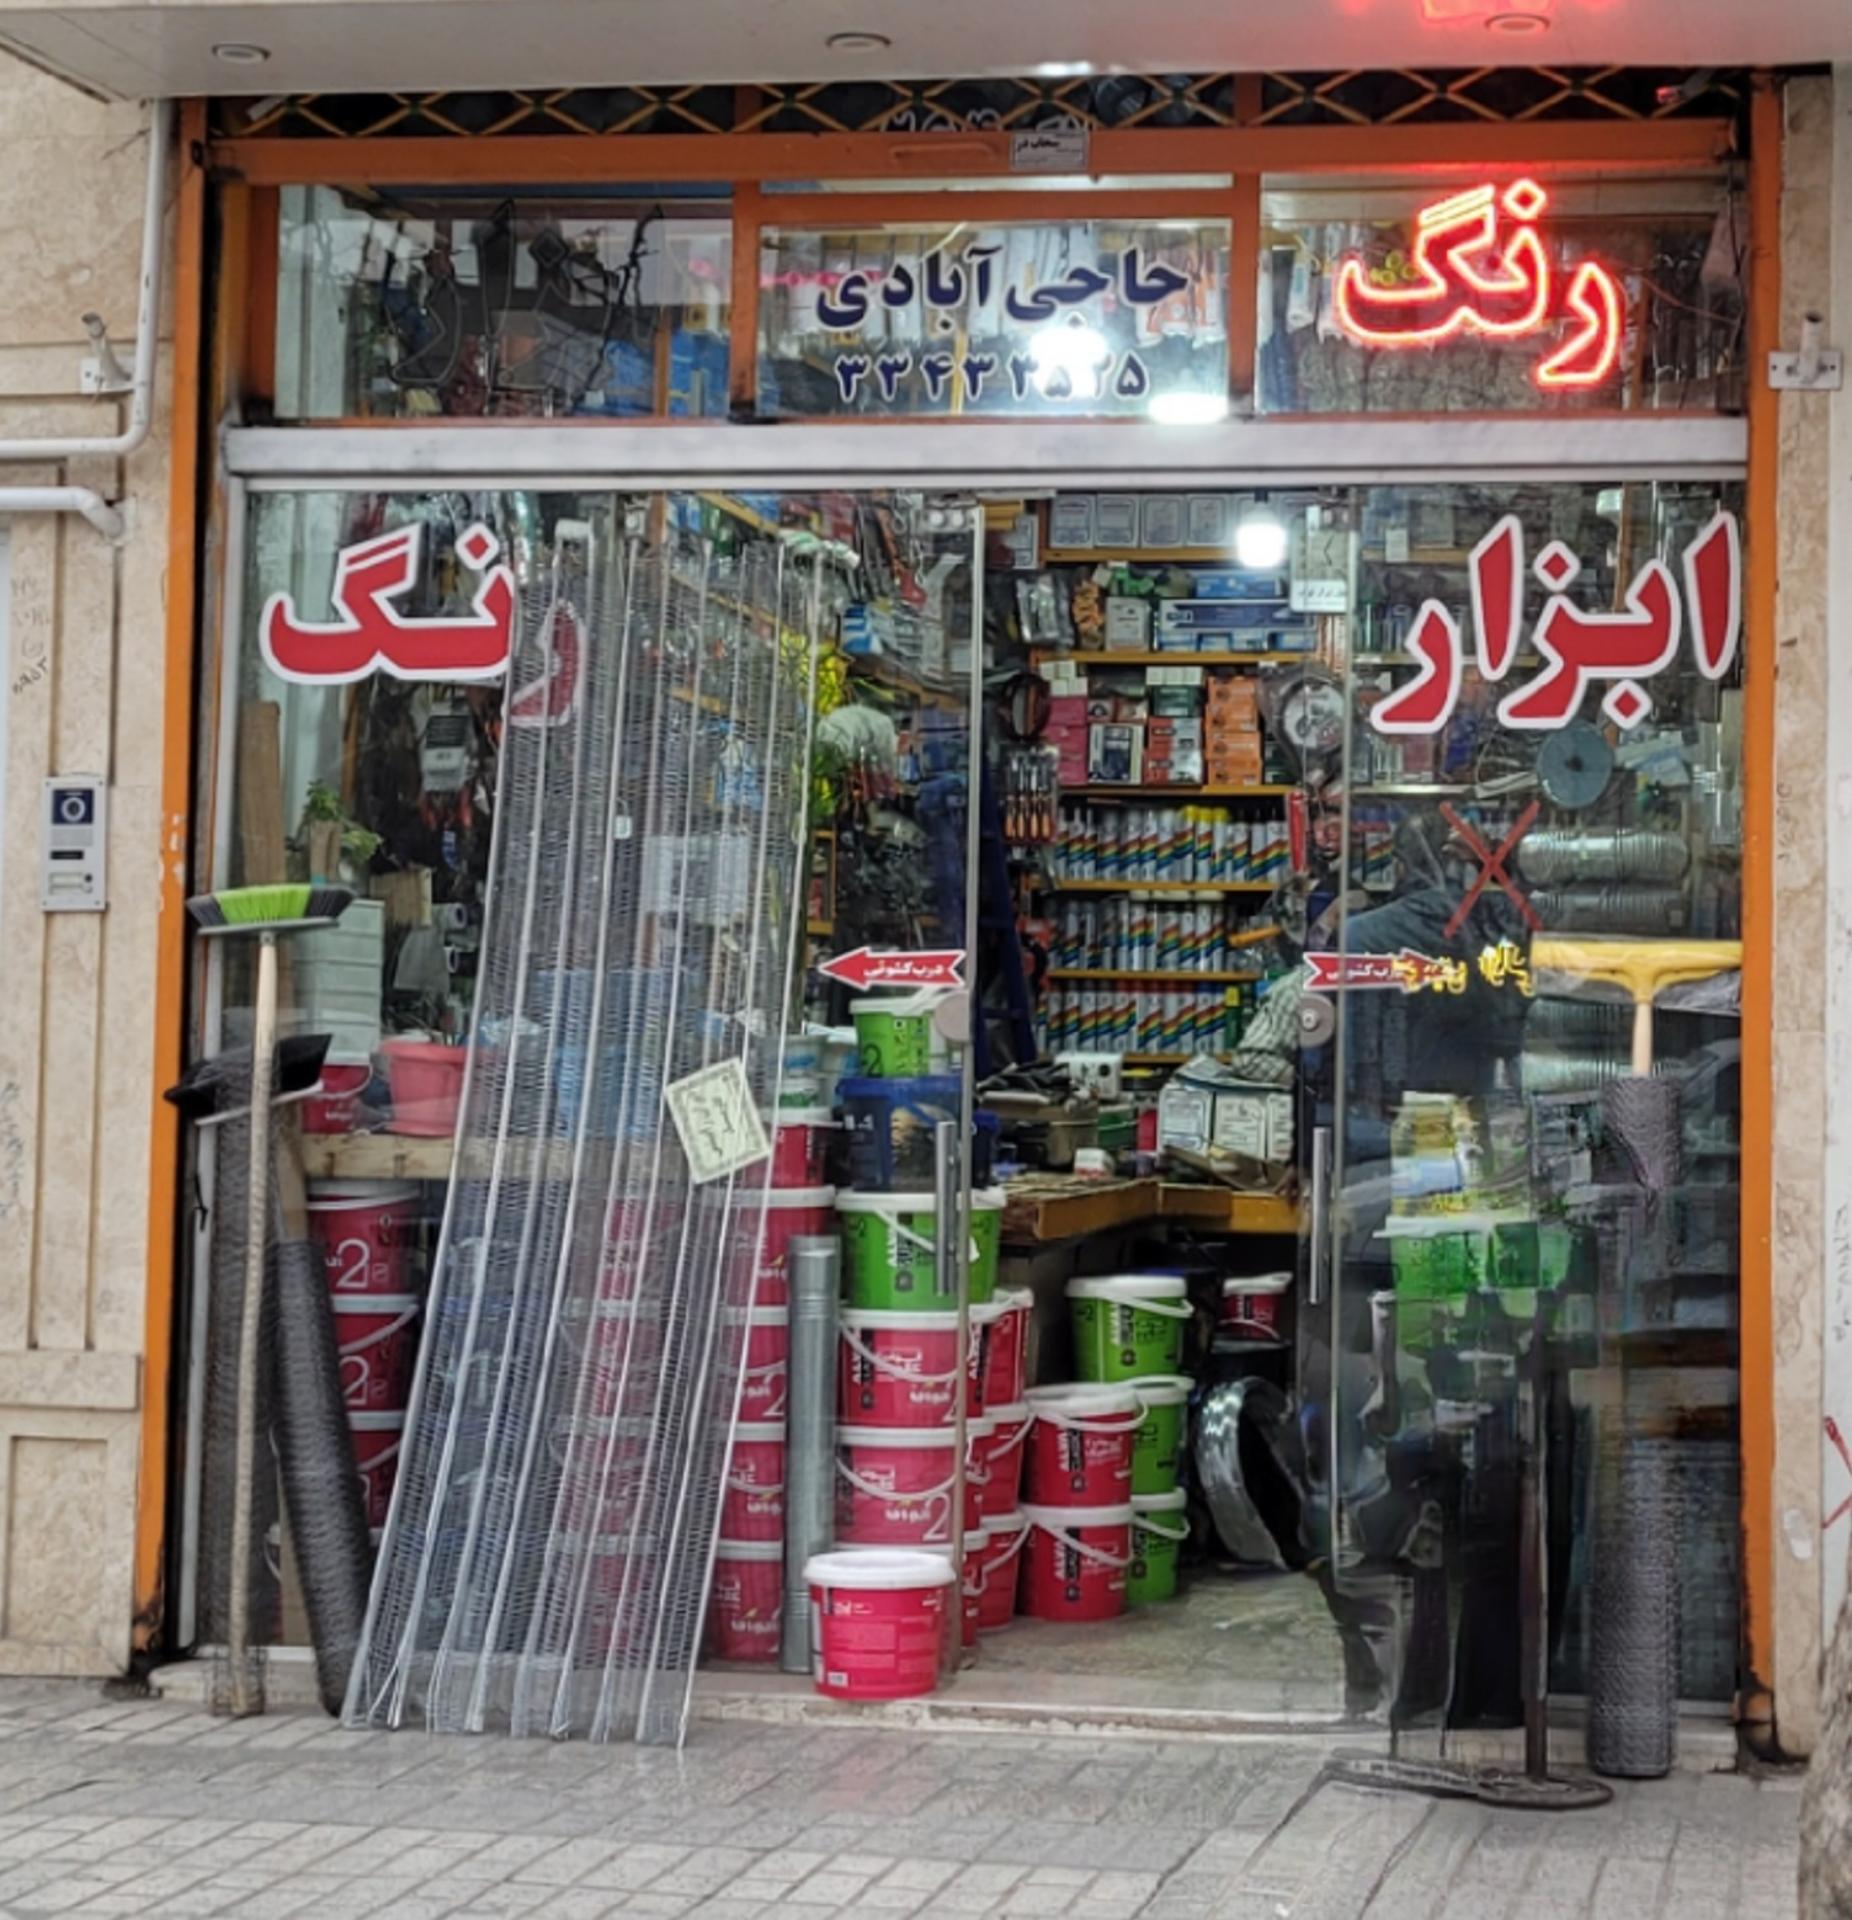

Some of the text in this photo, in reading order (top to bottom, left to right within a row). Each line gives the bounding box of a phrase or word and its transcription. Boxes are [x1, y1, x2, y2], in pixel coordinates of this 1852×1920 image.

[816, 245, 1190, 330] حاجی آبادی
[1333, 176, 1625, 388] رنگ
[260, 522, 590, 728] رنگ
[1370, 511, 1742, 734] ابزار
[922, 1491, 951, 1541] 2
